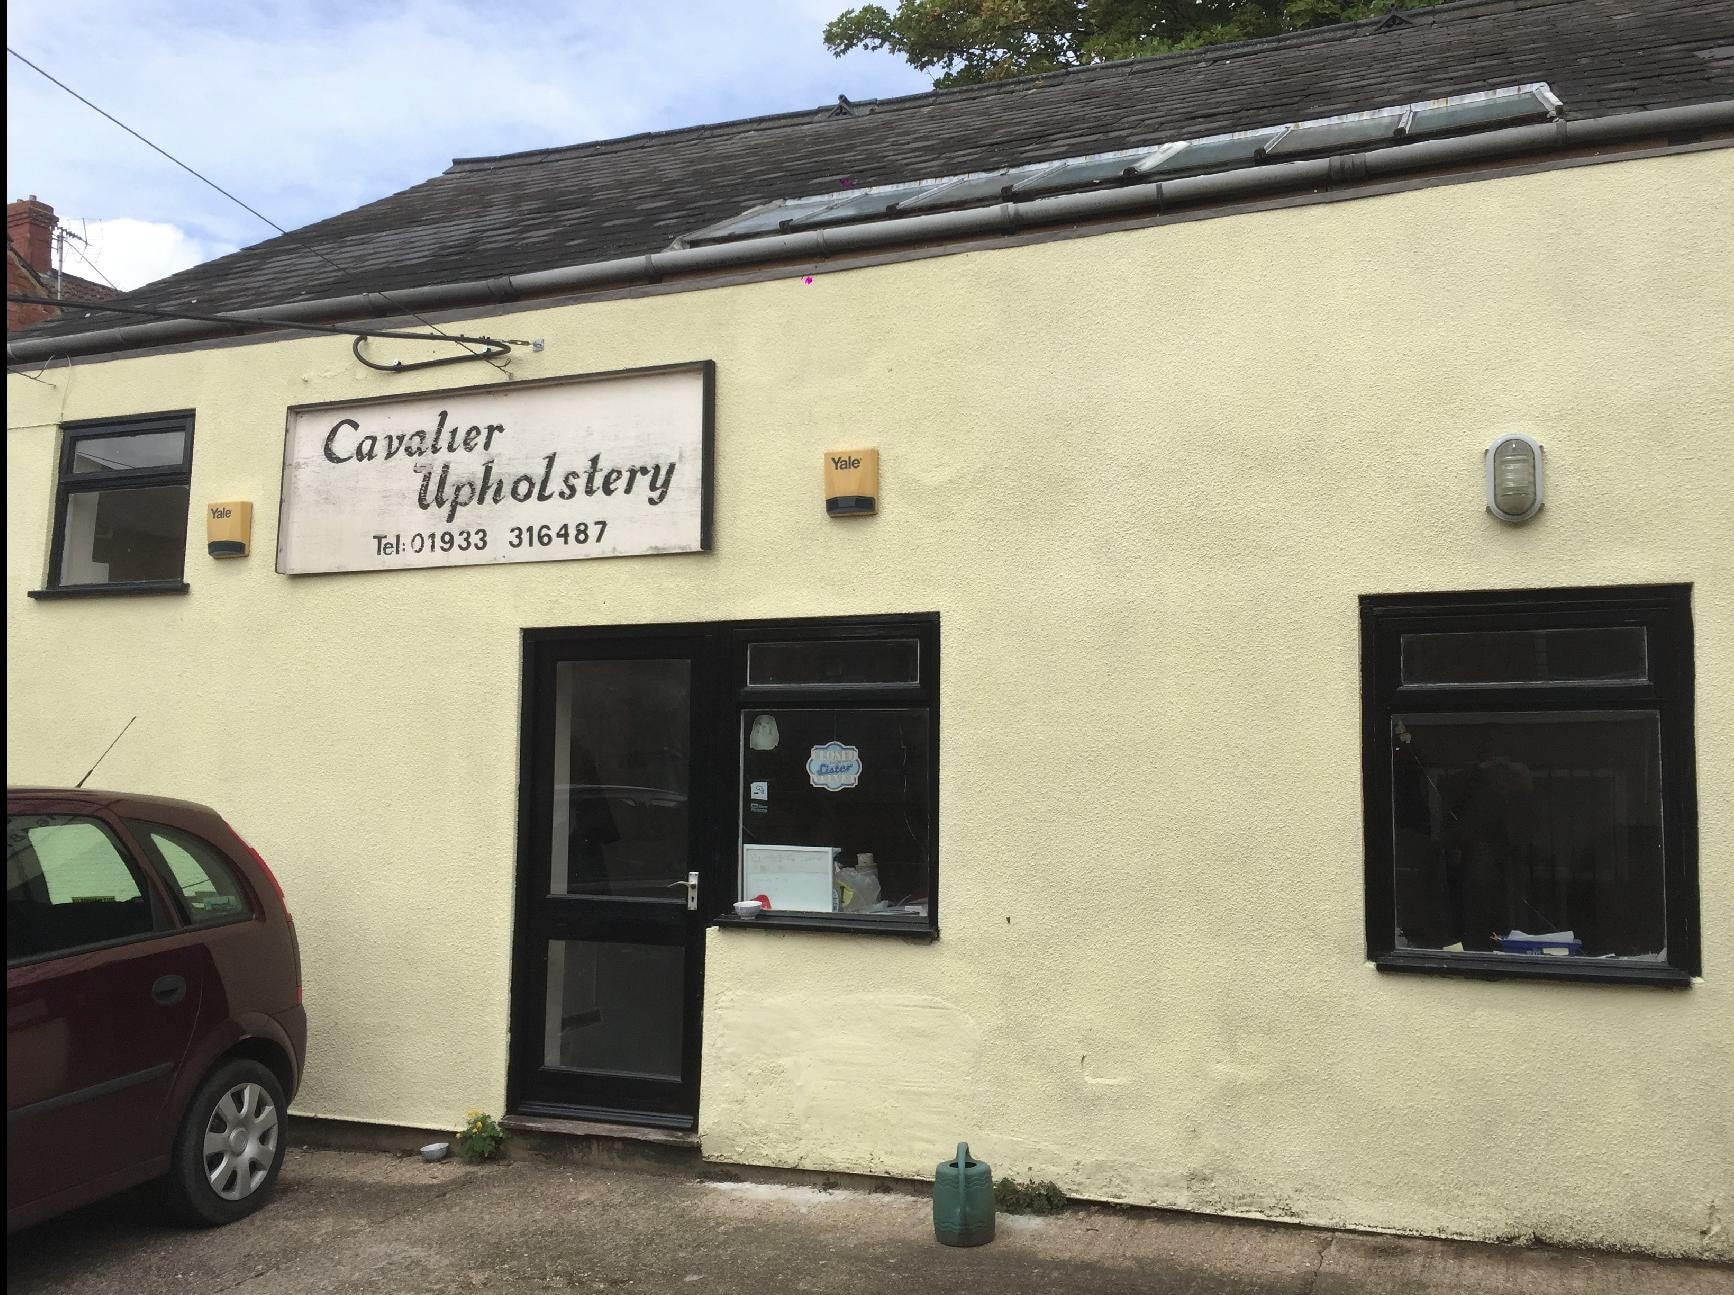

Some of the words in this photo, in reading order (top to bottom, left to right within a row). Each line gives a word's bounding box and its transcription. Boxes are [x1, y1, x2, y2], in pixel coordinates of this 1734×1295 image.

[323, 410, 505, 464] Cavalier
[831, 456, 861, 470] Yale
[413, 452, 677, 523] Upholstery
[211, 507, 232, 519] Yale
[508, 521, 608, 548] 316487
